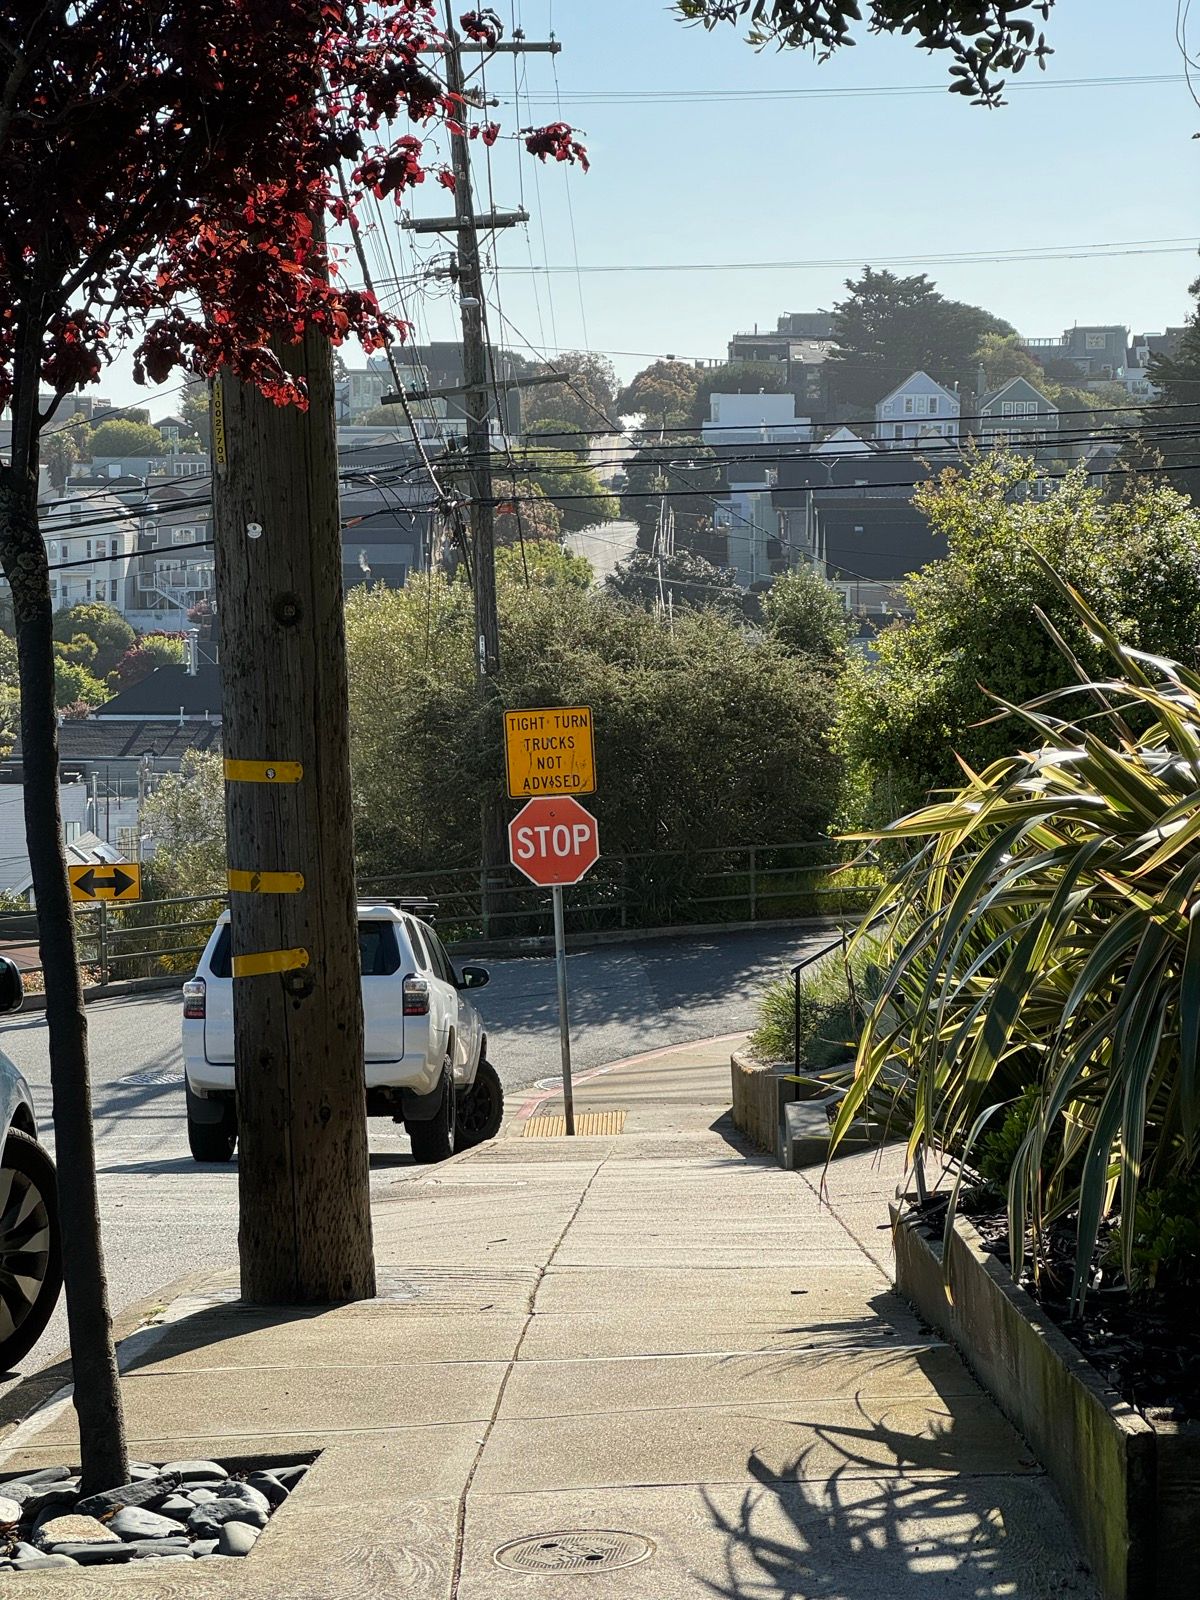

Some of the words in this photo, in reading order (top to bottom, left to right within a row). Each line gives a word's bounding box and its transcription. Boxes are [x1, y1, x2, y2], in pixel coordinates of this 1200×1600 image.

[509, 717, 545, 731] TIGHT
[554, 714, 588, 728] TURN
[524, 736, 575, 751] TRUCKS
[537, 756, 562, 769] NOT
[523, 775, 580, 790] ADVISED
[517, 824, 590, 859] STOP
